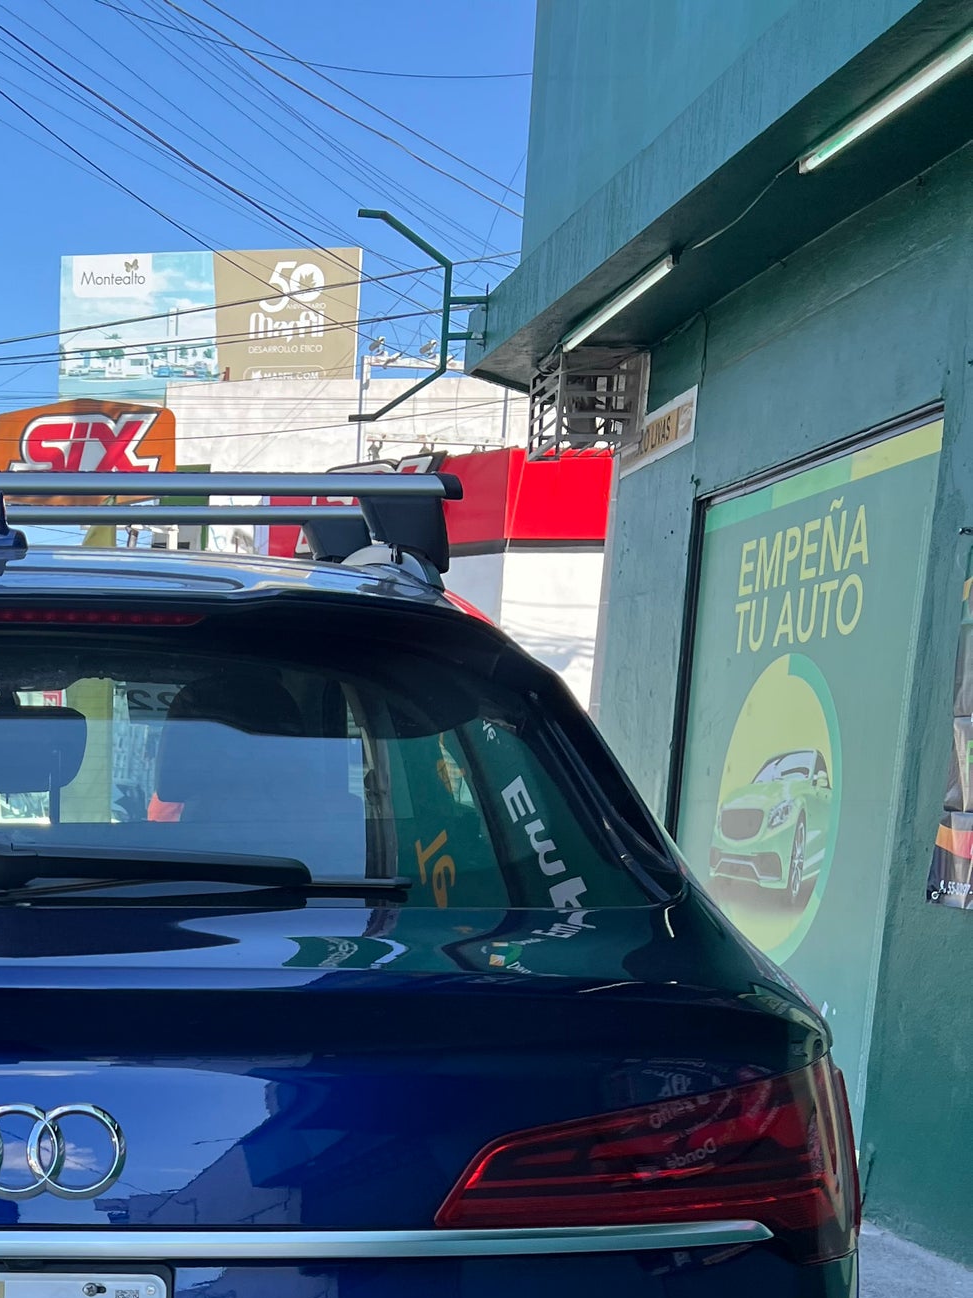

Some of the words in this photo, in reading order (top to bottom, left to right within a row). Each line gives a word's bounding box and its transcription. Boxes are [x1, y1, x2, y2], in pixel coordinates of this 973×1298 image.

[80, 270, 146, 286] Montealto
[258, 261, 325, 313] 50
[249, 310, 325, 343] Marfil
[248, 345, 299, 354] DESARROLLO
[738, 496, 869, 597] EMPEÑA
[735, 597, 769, 654] TU
[772, 573, 864, 648] AUTO
